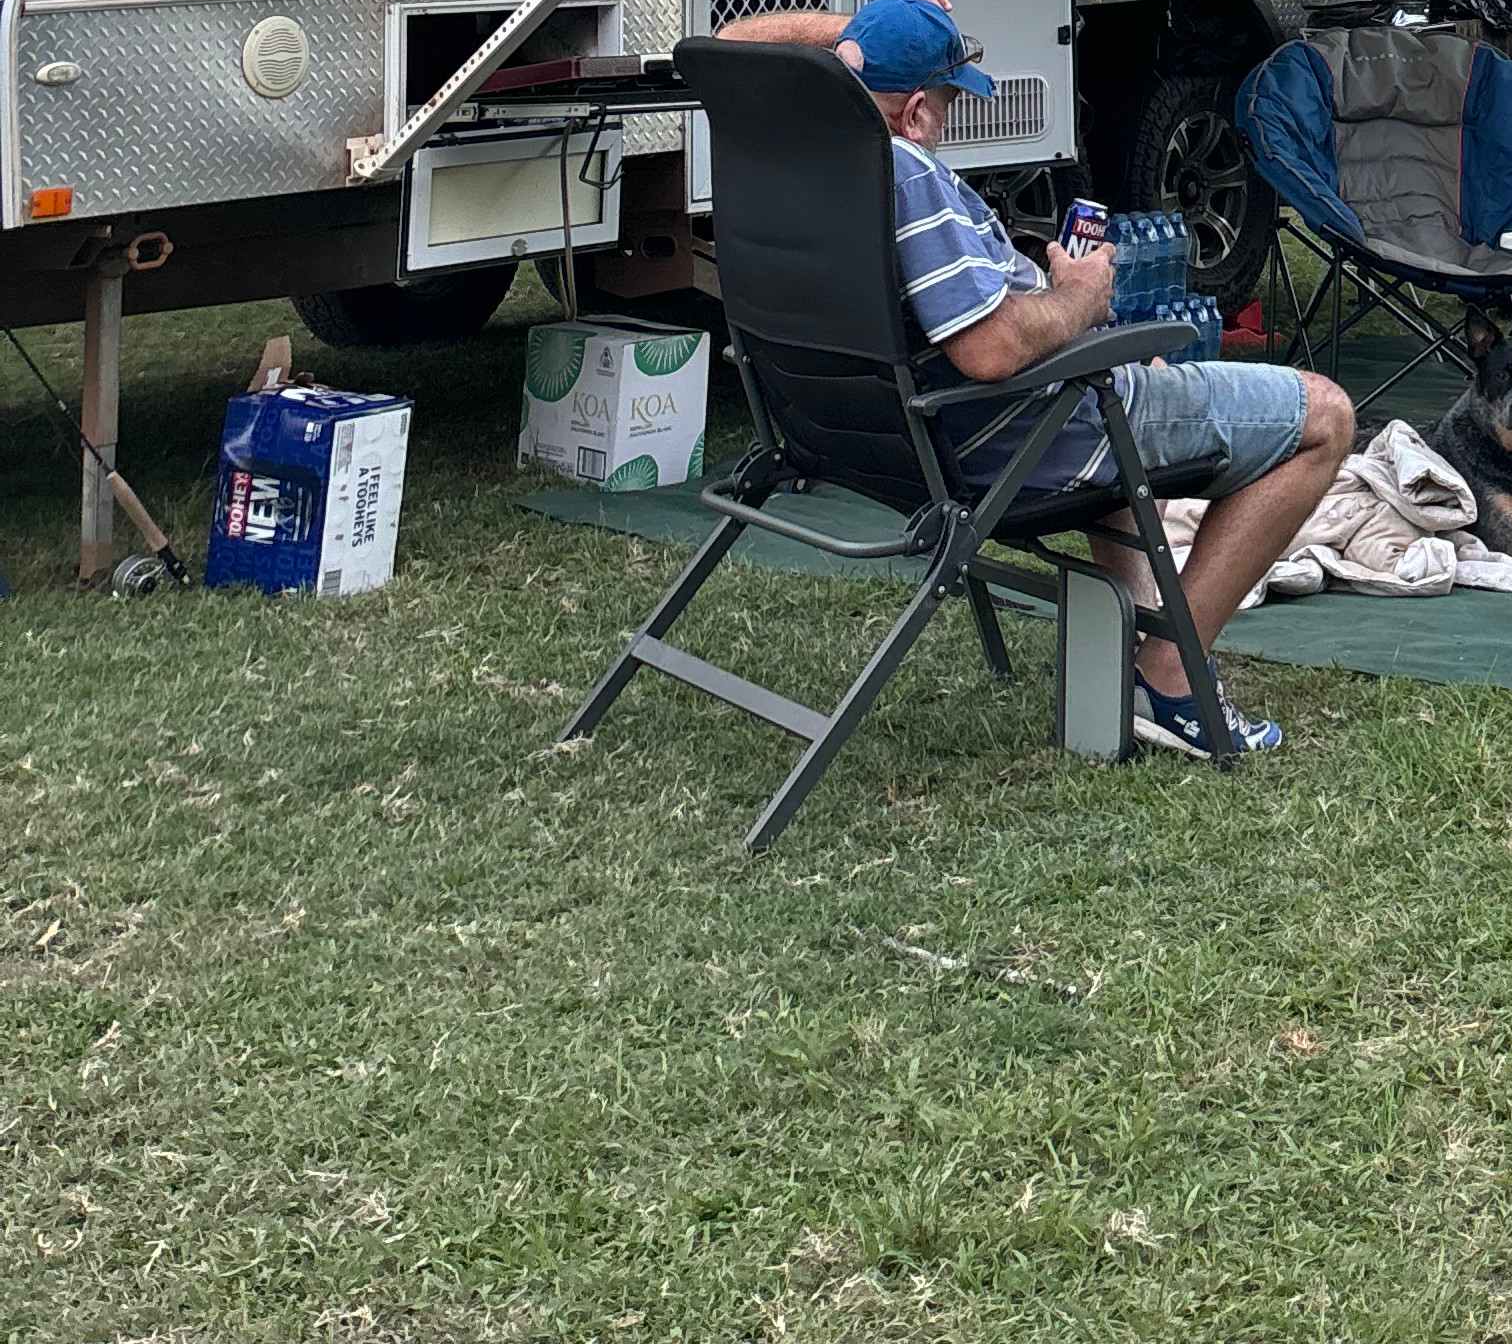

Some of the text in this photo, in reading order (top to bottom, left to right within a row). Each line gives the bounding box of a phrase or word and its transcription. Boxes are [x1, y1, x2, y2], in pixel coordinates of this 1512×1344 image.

[572, 391, 610, 424] KOA
[631, 391, 677, 424] KOA
[352, 467, 370, 548] A TOOHEYS
[366, 473, 381, 509] FEEL
[244, 475, 280, 545] NEW
[364, 512, 377, 544] LIKE
